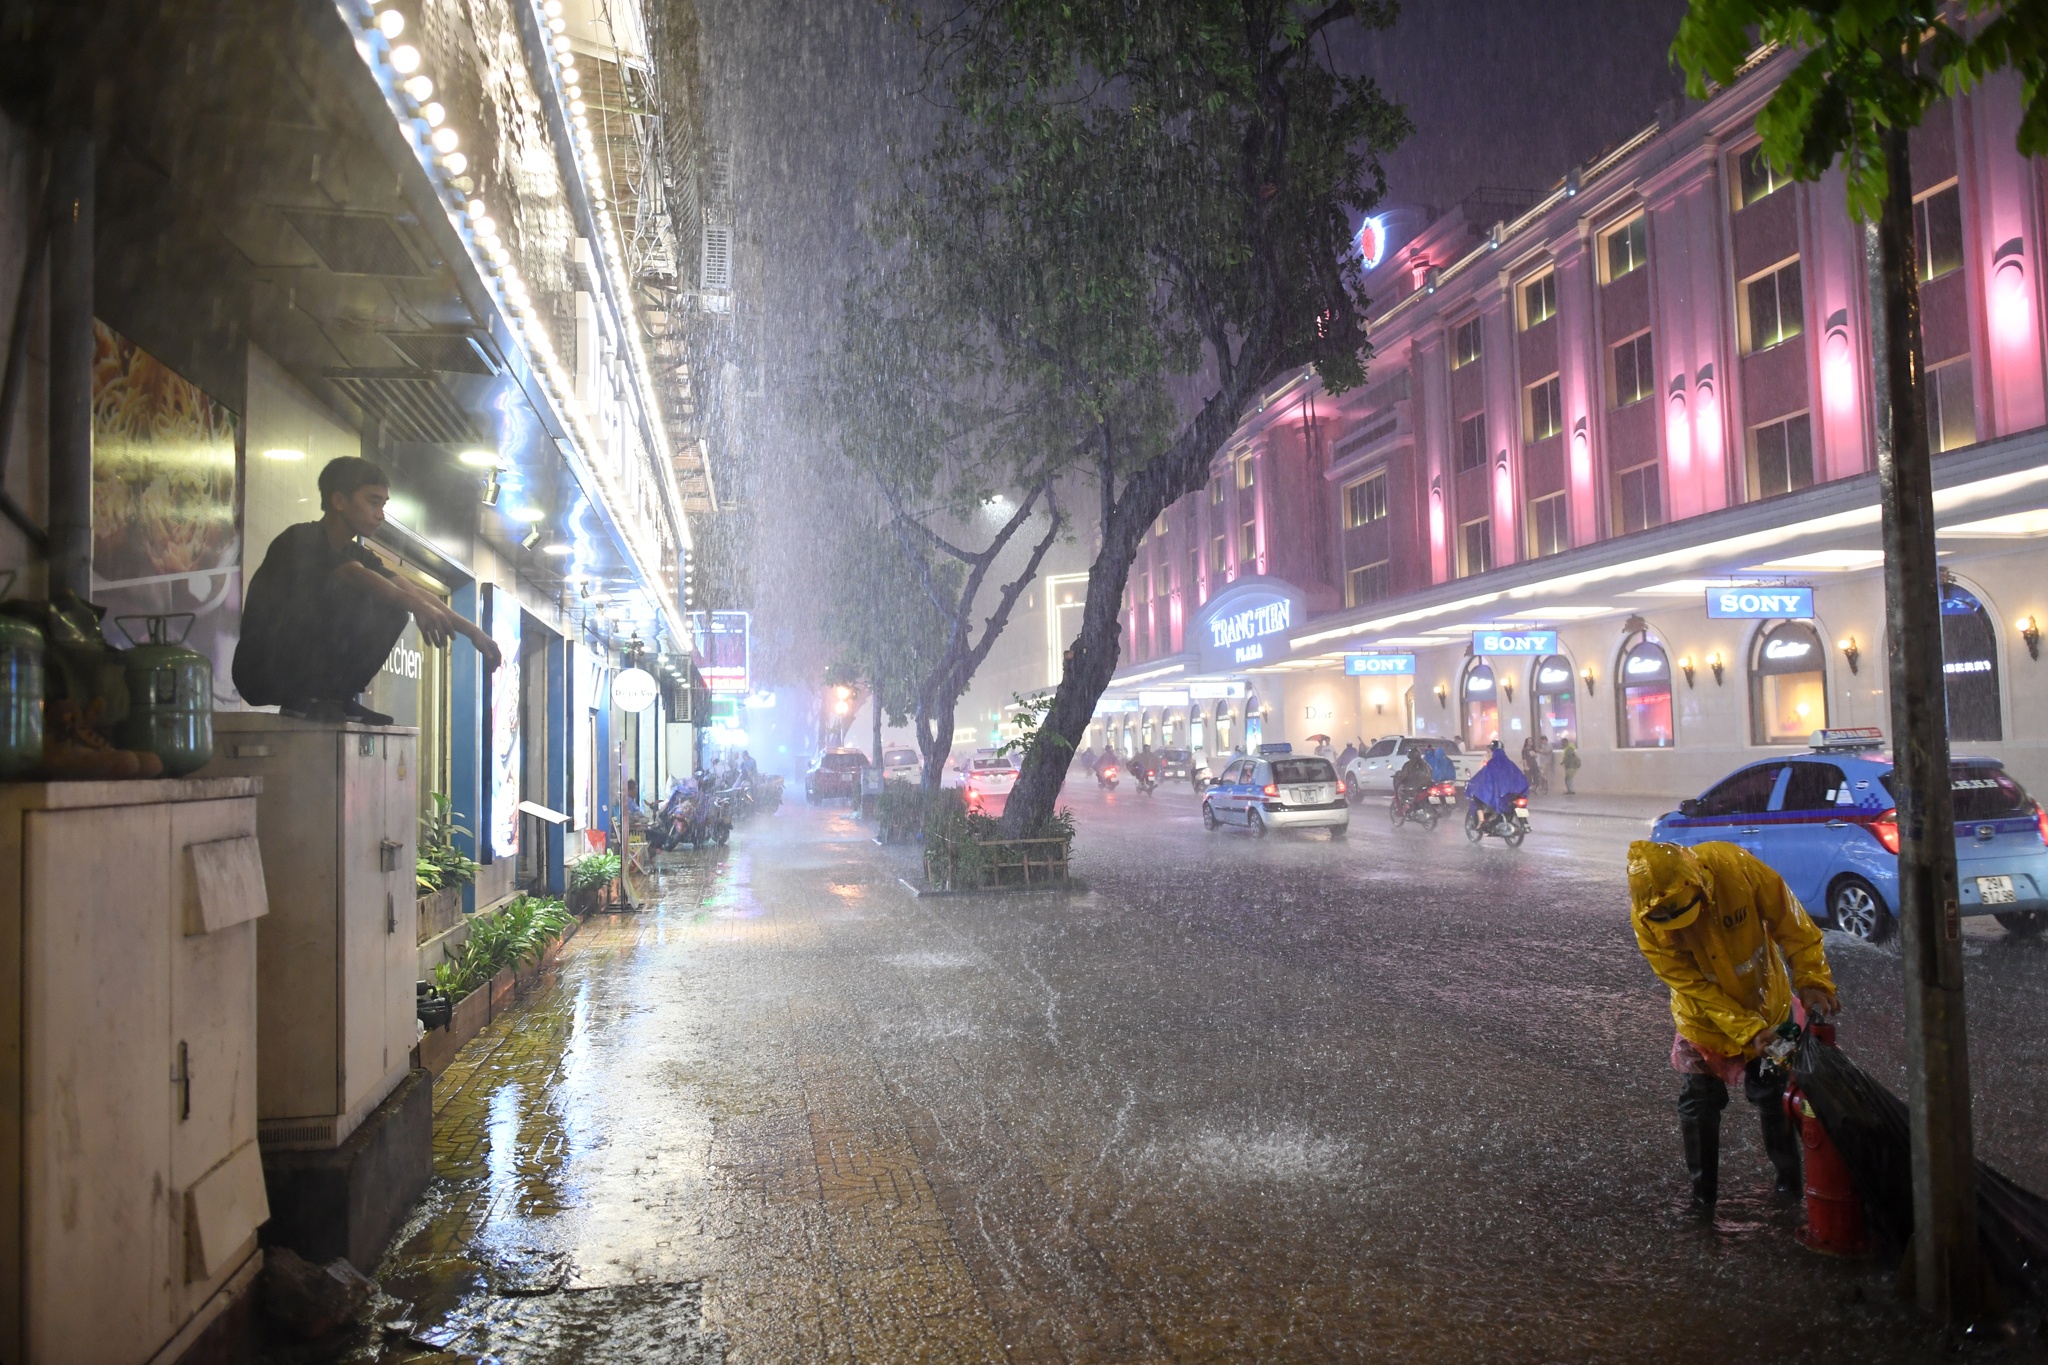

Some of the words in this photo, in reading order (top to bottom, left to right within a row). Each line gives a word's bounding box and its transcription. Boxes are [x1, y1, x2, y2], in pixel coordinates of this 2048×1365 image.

[1719, 594, 1801, 613] SONY
[1211, 609, 1255, 649] TRANG
[1483, 636, 1548, 651] SONY
[1235, 643, 1264, 664] PLAZA
[1353, 659, 1408, 672] SONY
